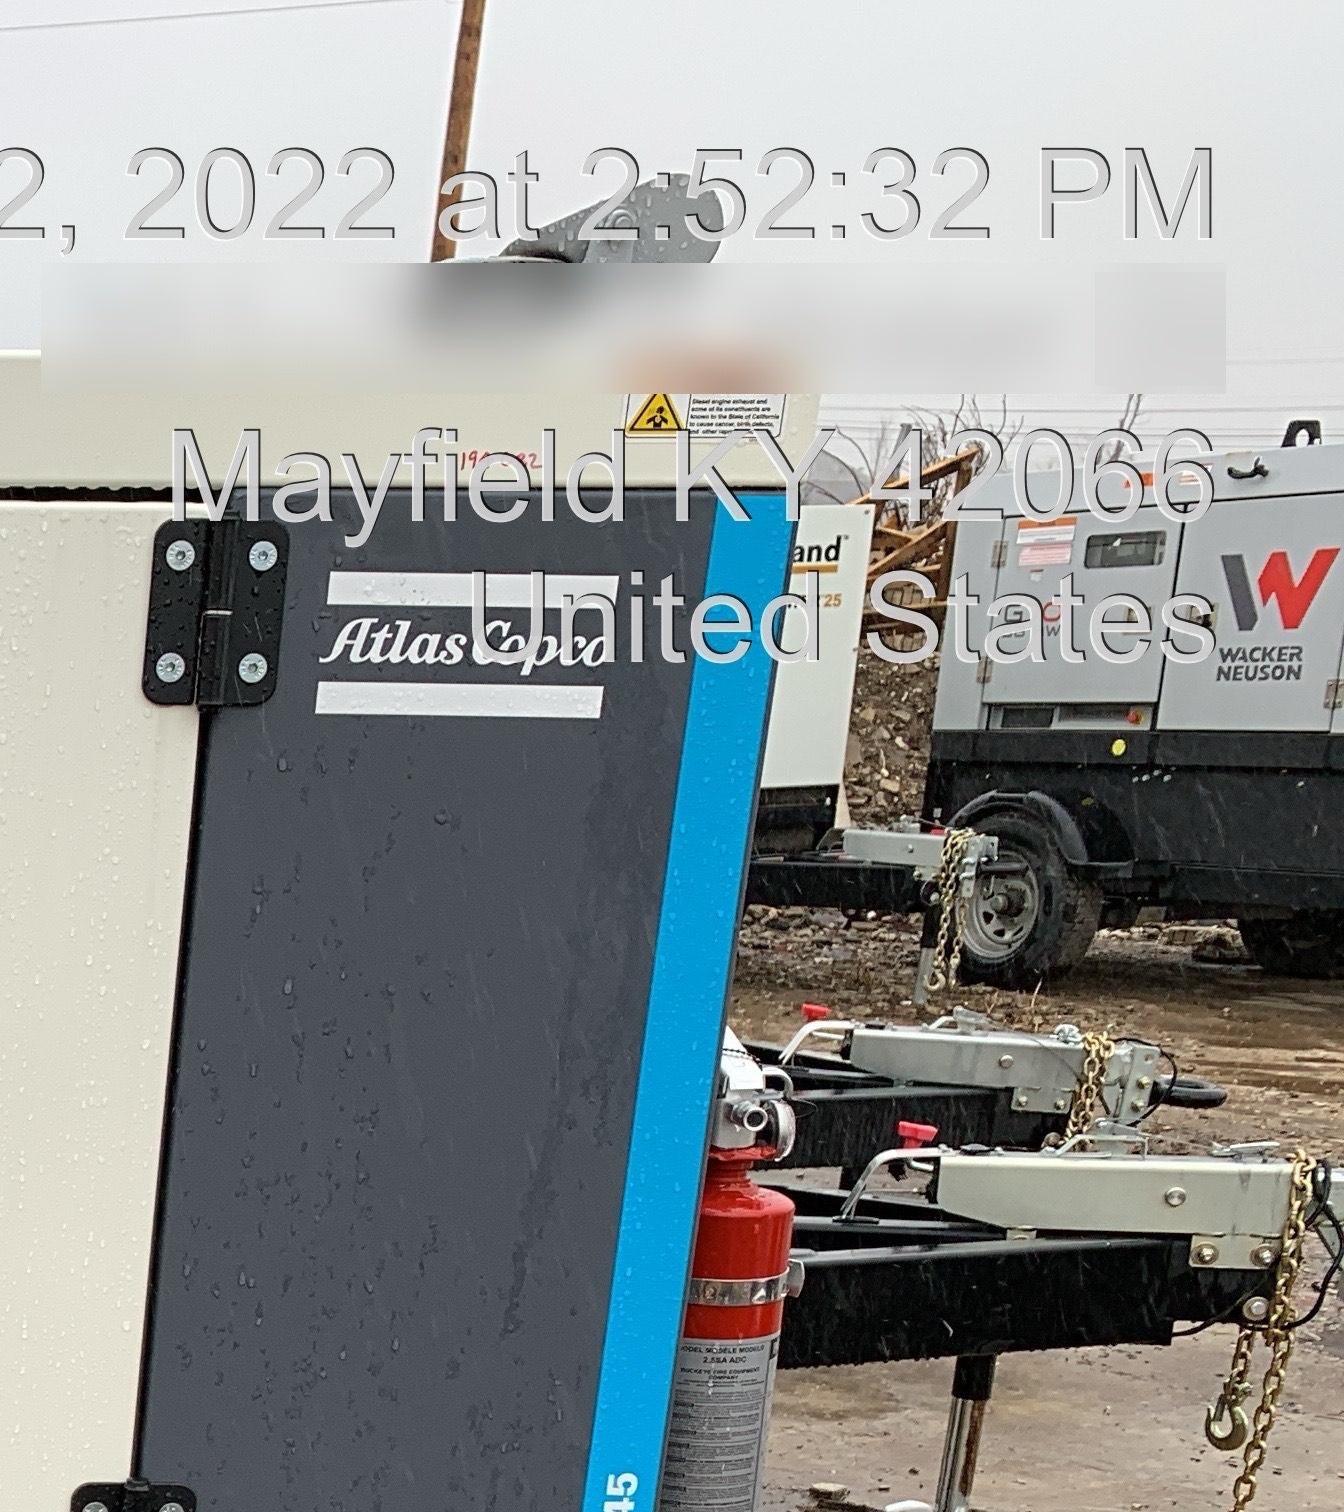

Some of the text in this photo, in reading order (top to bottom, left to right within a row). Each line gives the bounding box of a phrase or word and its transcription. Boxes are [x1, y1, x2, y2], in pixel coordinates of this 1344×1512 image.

[319, 617, 465, 665] Atlas
[1219, 646, 1303, 663] WACKER
[1216, 664, 1302, 681] NEUSON
